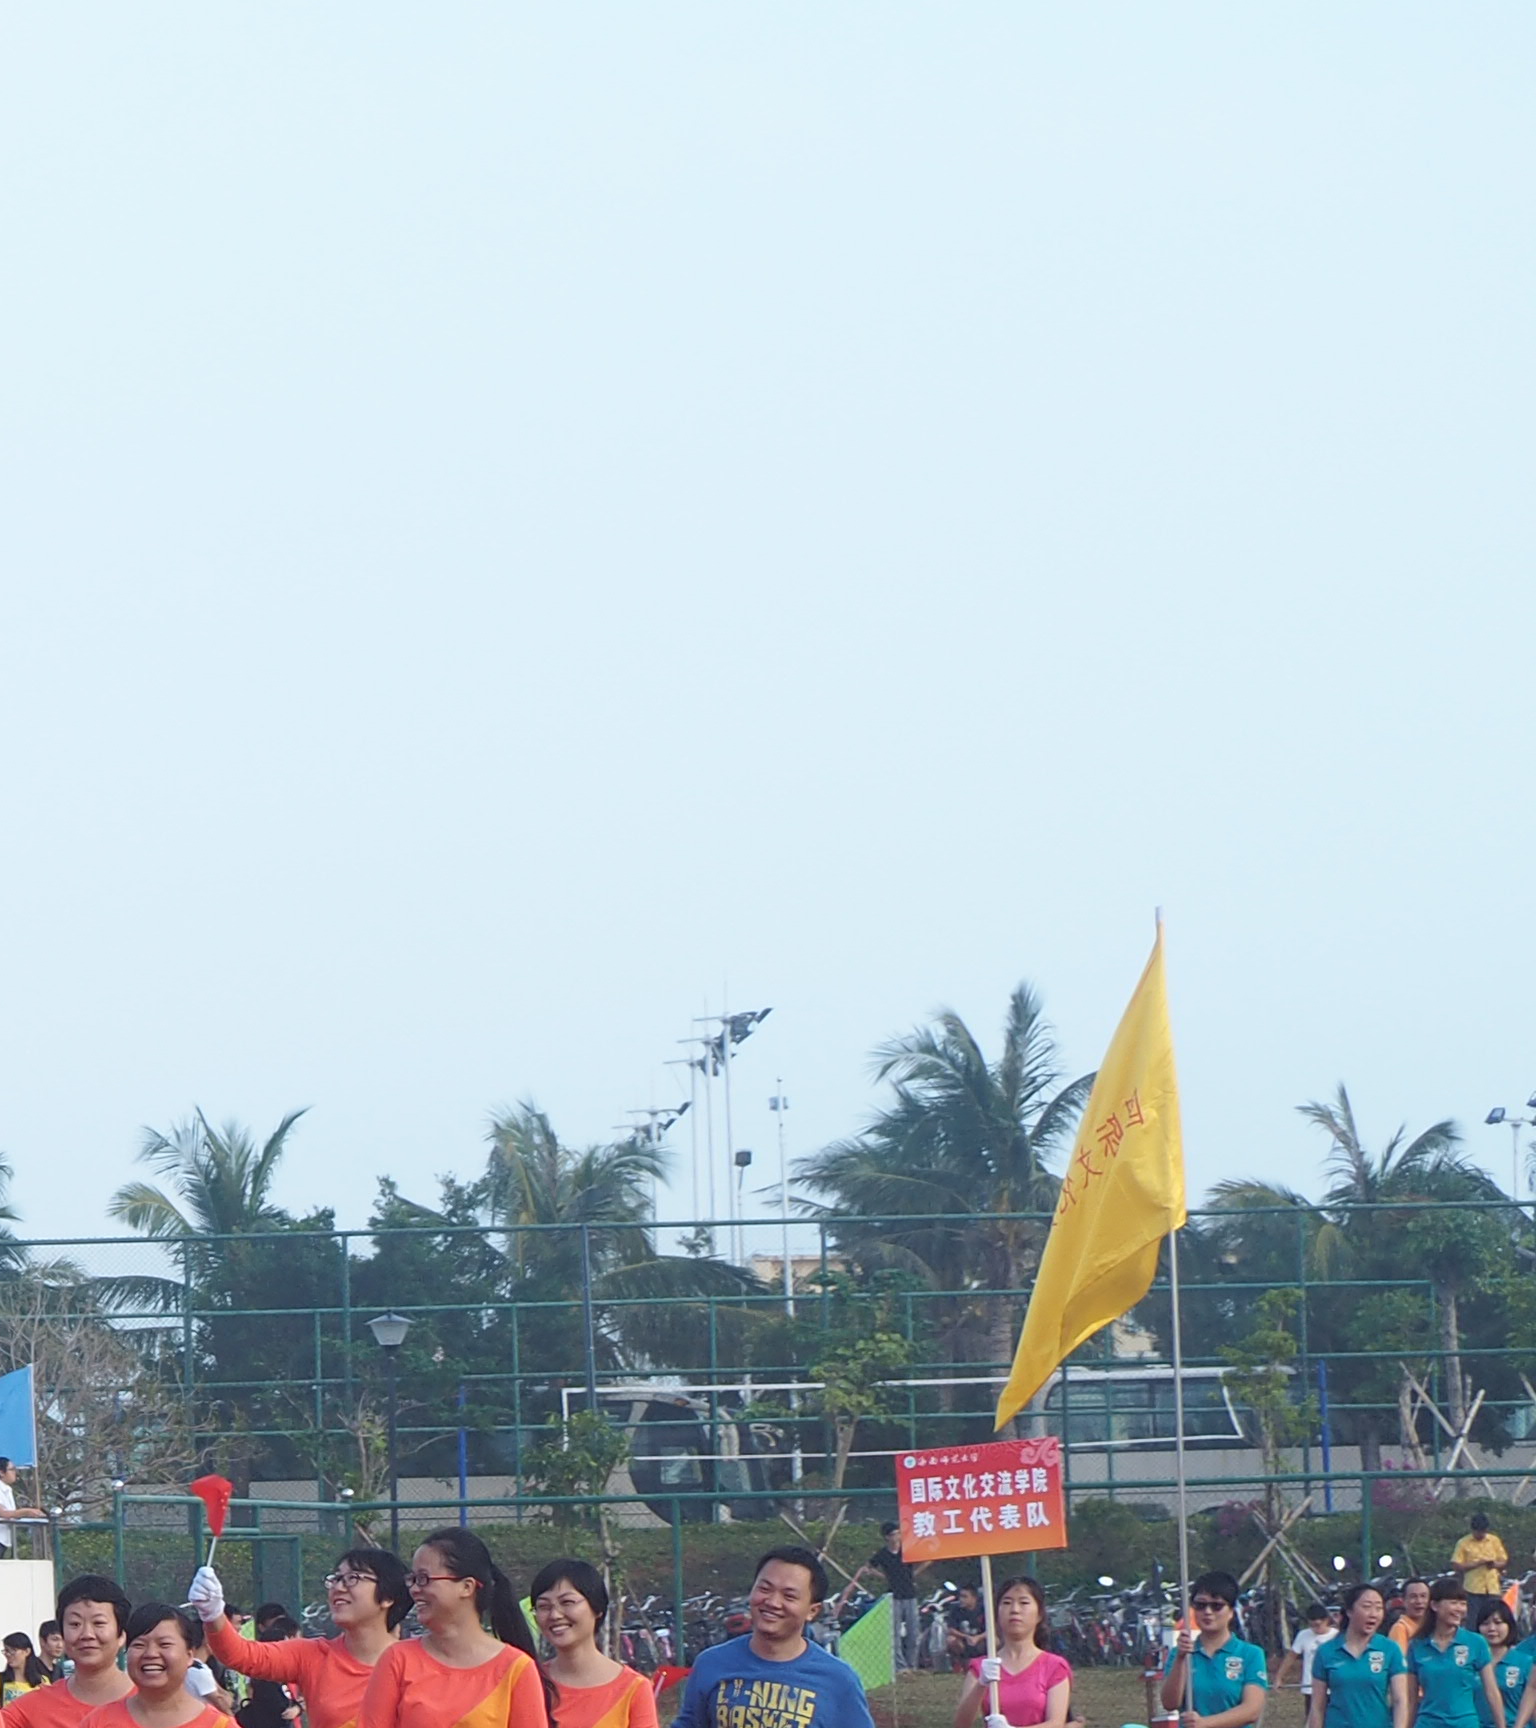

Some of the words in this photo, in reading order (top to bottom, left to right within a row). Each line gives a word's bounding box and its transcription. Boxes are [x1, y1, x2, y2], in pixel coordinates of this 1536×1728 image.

[910, 1467, 1048, 1504] 国际文化交流学院
[912, 1501, 1050, 1538] 教工代表队
